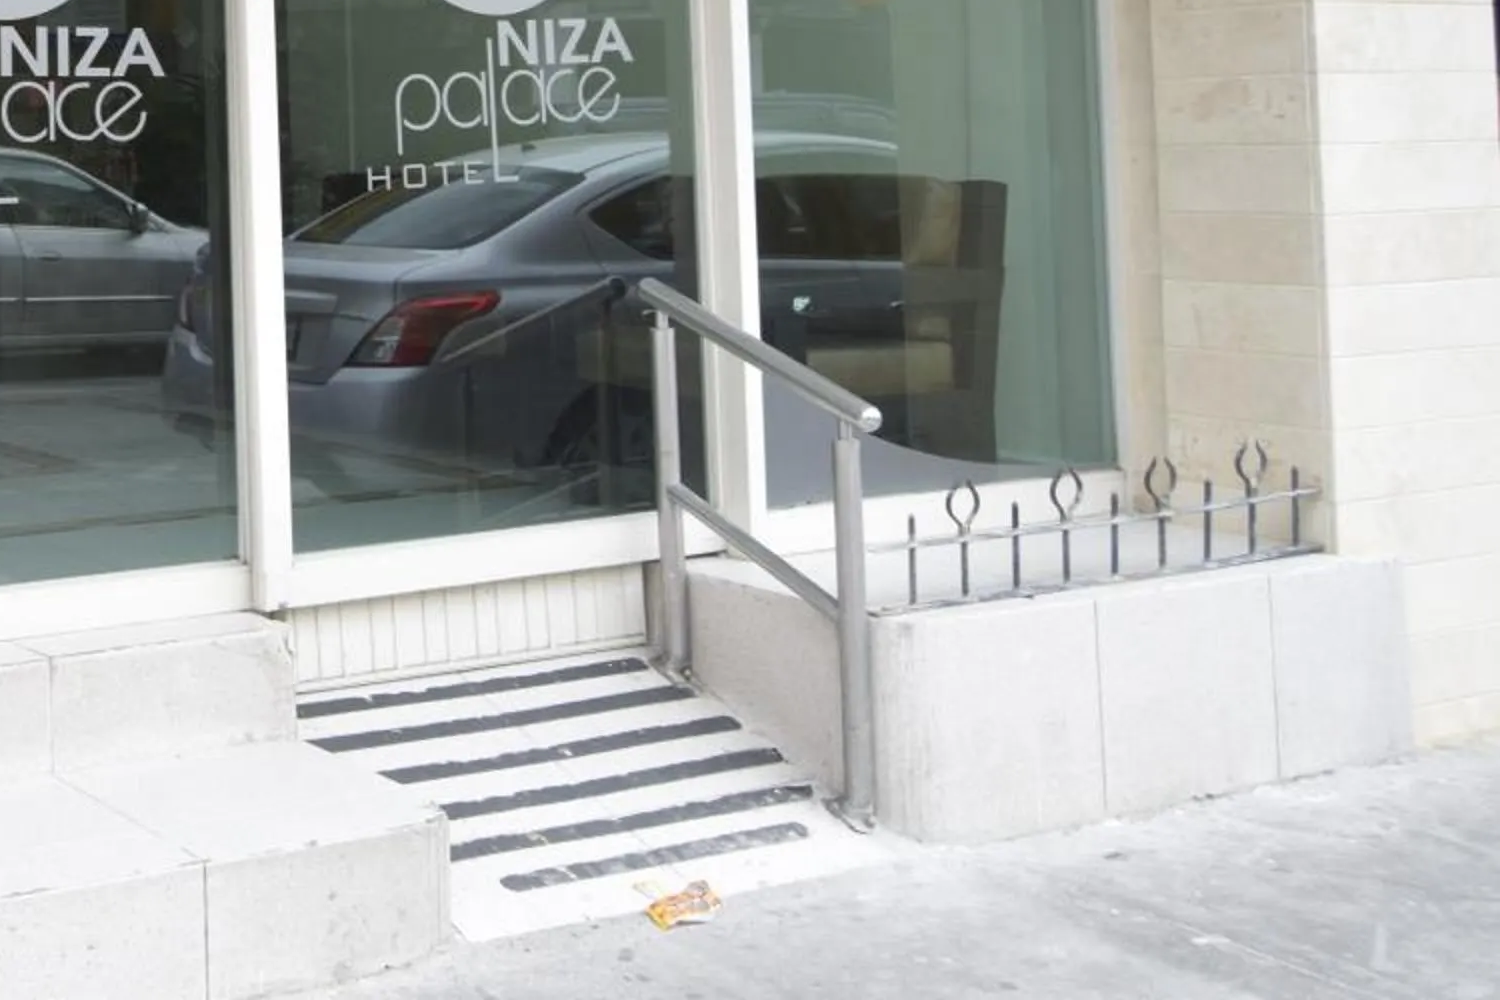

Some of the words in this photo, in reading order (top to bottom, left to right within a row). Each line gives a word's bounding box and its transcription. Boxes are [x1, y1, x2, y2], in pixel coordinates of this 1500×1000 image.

[0, 25, 165, 77] NIZA
[498, 18, 634, 69] NIZA
[395, 38, 621, 155] palace
[366, 160, 519, 192] HOTEL
